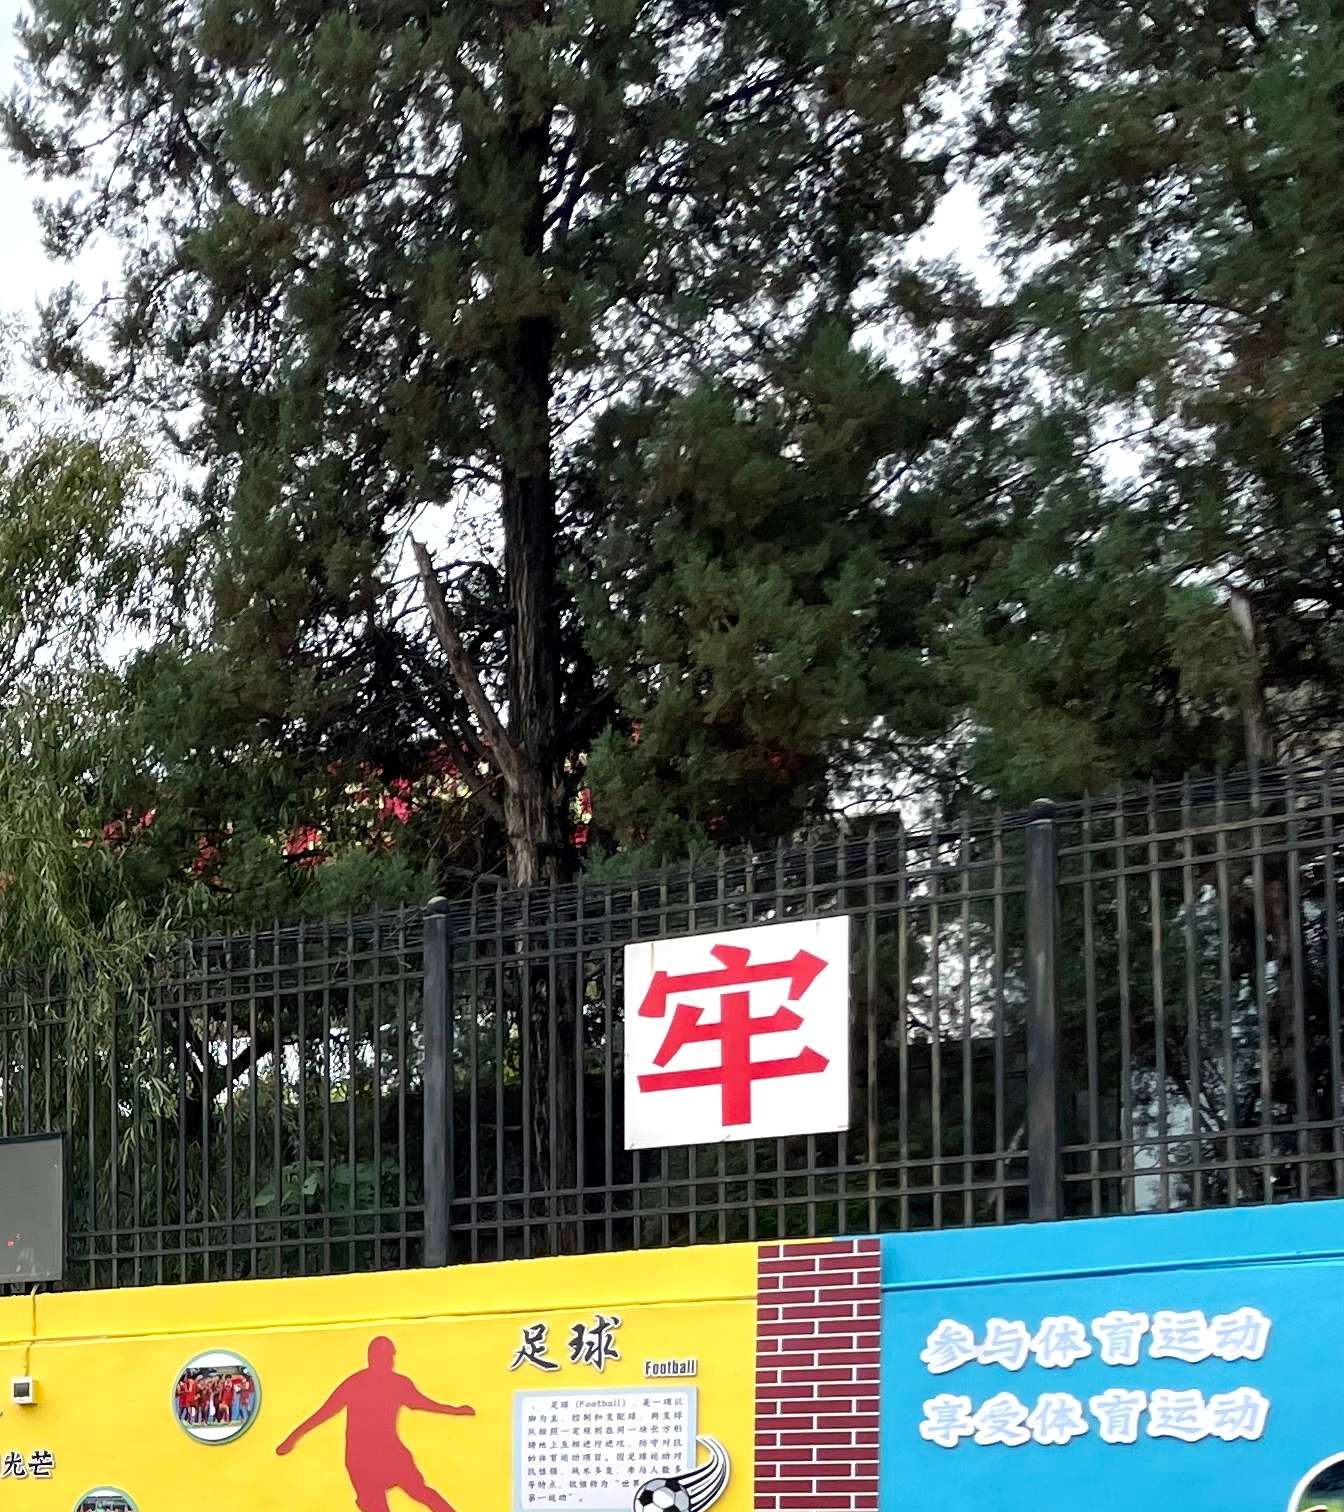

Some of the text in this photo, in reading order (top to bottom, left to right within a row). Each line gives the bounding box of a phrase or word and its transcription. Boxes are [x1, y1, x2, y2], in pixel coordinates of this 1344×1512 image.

[636, 943, 830, 1127] 牢
[510, 1314, 621, 1371] 足球
[645, 1359, 696, 1377] Football
[923, 1309, 1266, 1371] 参与体育运动
[923, 1390, 1266, 1445] 享受体育运动
